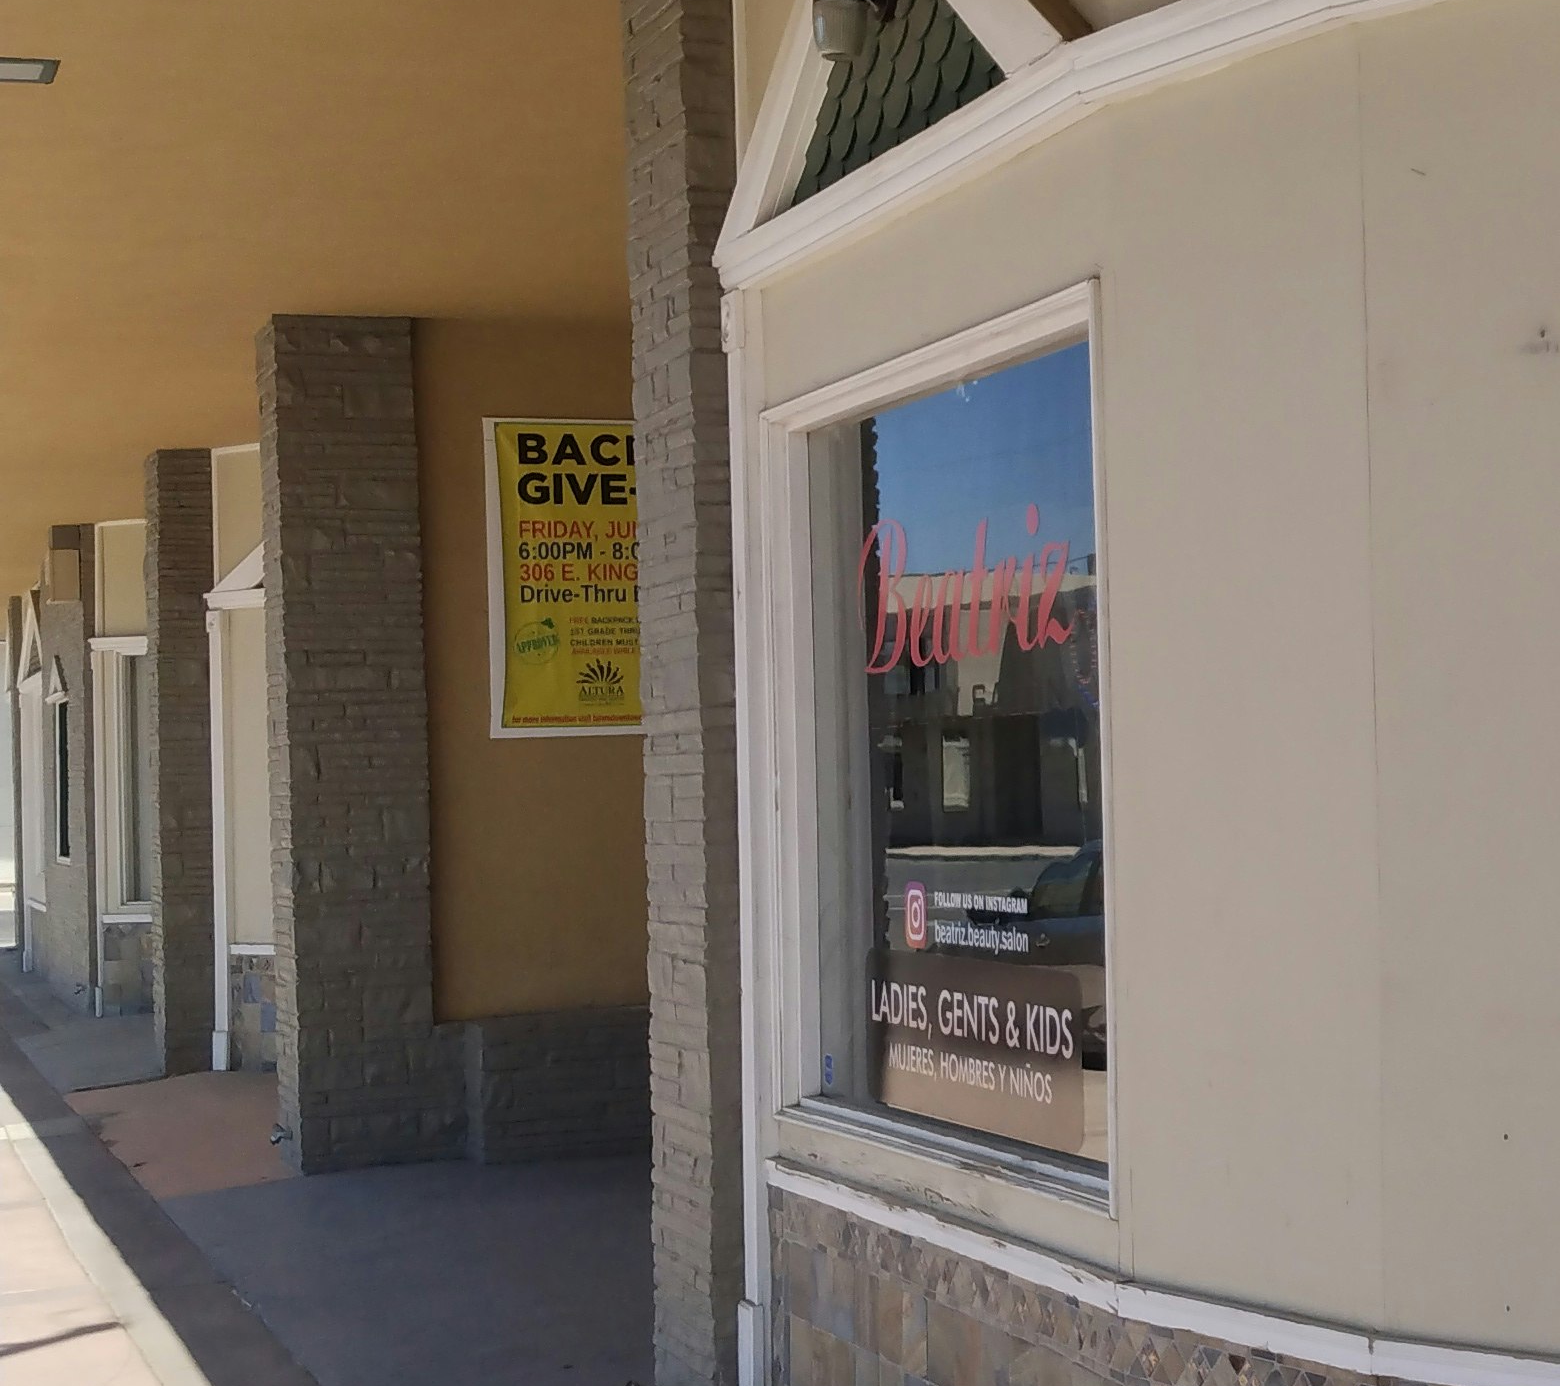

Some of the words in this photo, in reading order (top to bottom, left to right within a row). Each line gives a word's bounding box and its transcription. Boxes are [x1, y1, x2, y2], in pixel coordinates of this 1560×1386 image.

[519, 520, 598, 541] FRIDAY,
[518, 541, 593, 560] 6:00PM
[520, 563, 555, 582] 306
[561, 563, 580, 581] E.
[588, 563, 638, 582] KING
[520, 584, 627, 603] Drive-Thru
[858, 502, 1076, 674] Beatriz
[934, 891, 961, 908] FOLLOW
[963, 893, 972, 909] US
[974, 894, 984, 910] ON
[985, 895, 1028, 914] INSTAGRAM
[935, 919, 1029, 955] beatriz.beauty.salon
[871, 979, 932, 1040] LADIES,
[938, 989, 1000, 1045] GENTS
[1005, 1000, 1020, 1048] &
[1026, 1003, 1074, 1059] KIDS
[889, 1042, 937, 1082] MUJERES,
[940, 1051, 995, 1091] HOMBRES
[998, 1063, 1006, 1093] Y
[1009, 1062, 1053, 1105] NIÑOS
